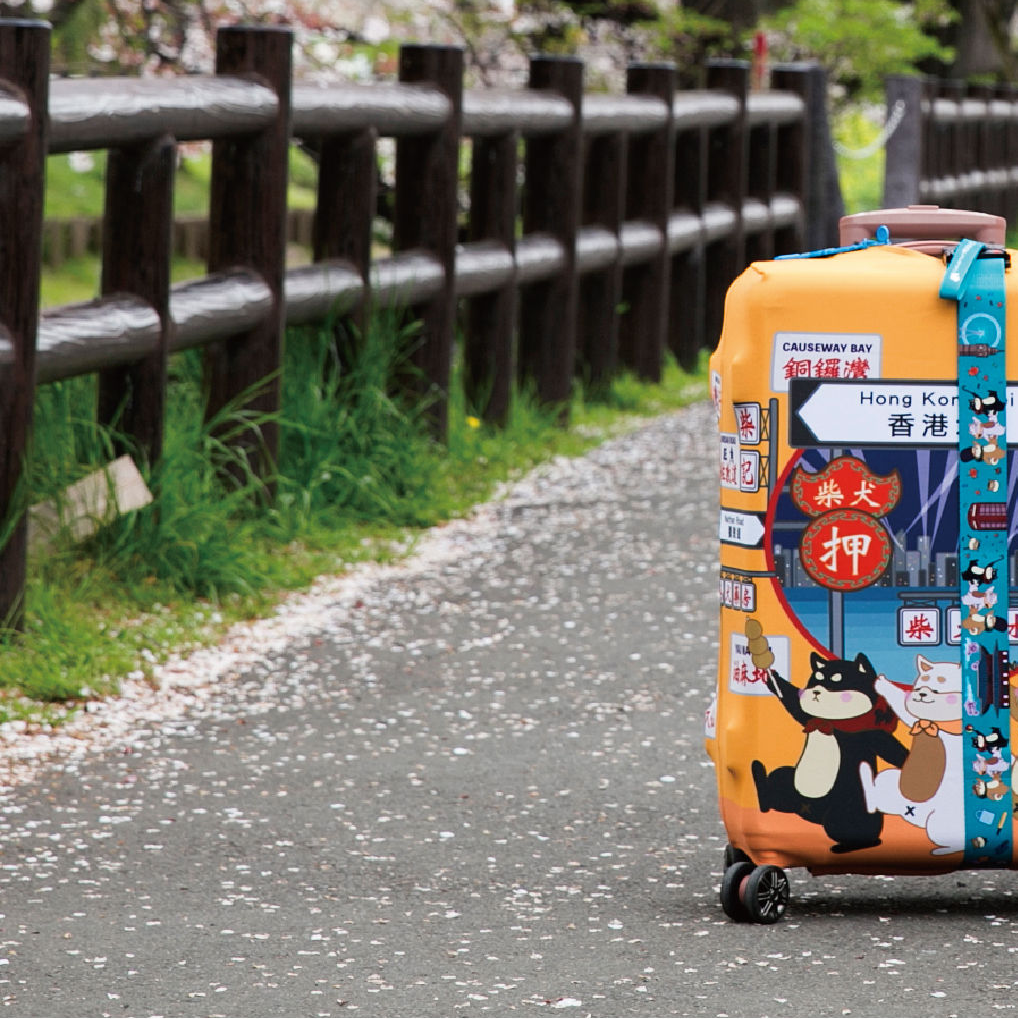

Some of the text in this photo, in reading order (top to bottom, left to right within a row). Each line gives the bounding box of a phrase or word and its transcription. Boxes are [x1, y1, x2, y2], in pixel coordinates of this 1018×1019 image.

[782, 342, 873, 353] CAUSEWAY BAY
[860, 391, 913, 408] Hong
[888, 413, 960, 437] 香港
[814, 478, 881, 508] 柴犬
[819, 526, 872, 576] 押
[905, 613, 934, 639] 柴
